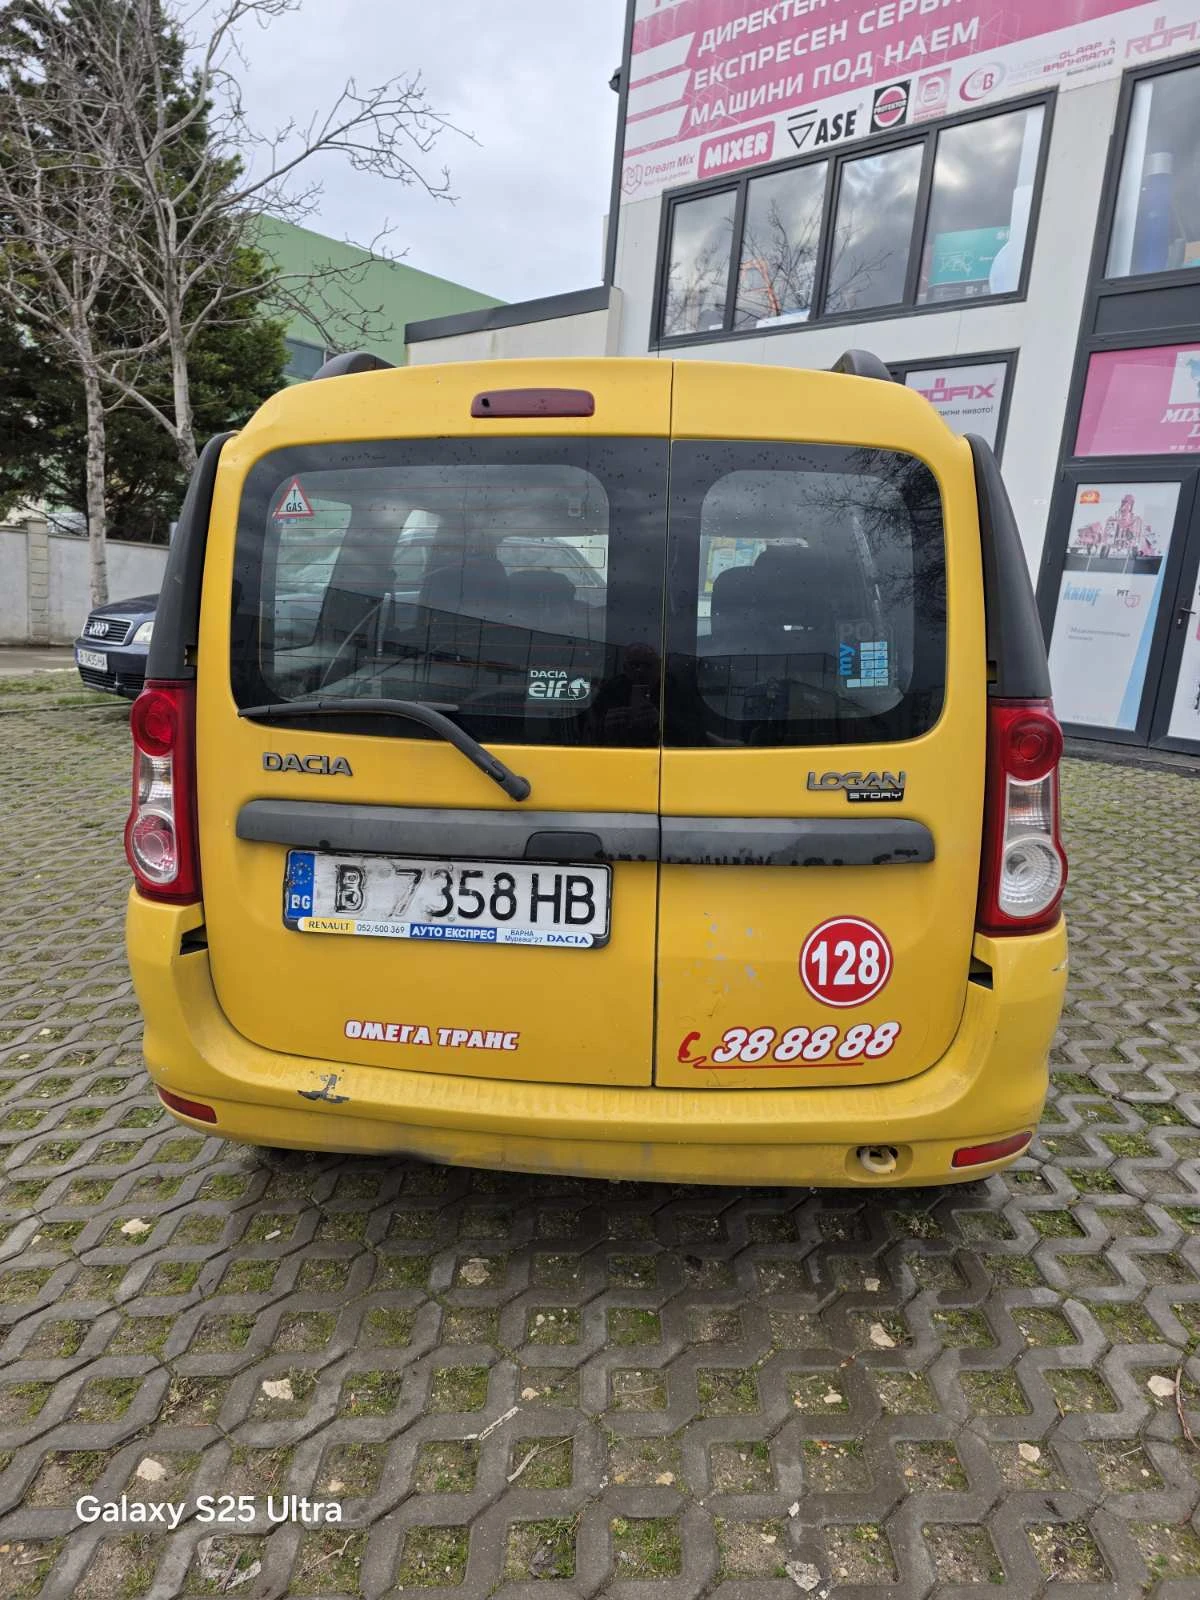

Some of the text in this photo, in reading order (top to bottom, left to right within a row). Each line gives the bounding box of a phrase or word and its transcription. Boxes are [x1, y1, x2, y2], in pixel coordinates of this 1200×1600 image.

[693, 0, 971, 90] ЕКСПРЕСЕН СЕРВ
[1125, 15, 1200, 59] RÖFI
[690, 73, 804, 127] МАШИНИ
[812, 50, 874, 89] ПОД
[884, 16, 980, 67] НАЕМ
[703, 131, 769, 170] MIXER
[644, 161, 676, 177] Dream
[677, 154, 696, 168] Mix
[917, 378, 995, 402] ÖFIX
[286, 502, 303, 513] GAS
[839, 641, 856, 676] my
[530, 670, 568, 678] DACIA
[529, 680, 568, 698] elf
[262, 752, 353, 776] DACIA
[806, 770, 906, 791] LOGAN
[291, 894, 311, 909] BG
[389, 867, 517, 921] 7358
[530, 873, 596, 925] HB
[308, 920, 349, 931] RENAULT
[412, 925, 495, 940] АУТО ЕКСПРЕС
[547, 934, 589, 945] DACIA
[811, 940, 880, 986] 128
[344, 1020, 520, 1050] ОМЕГА ТРАНС
